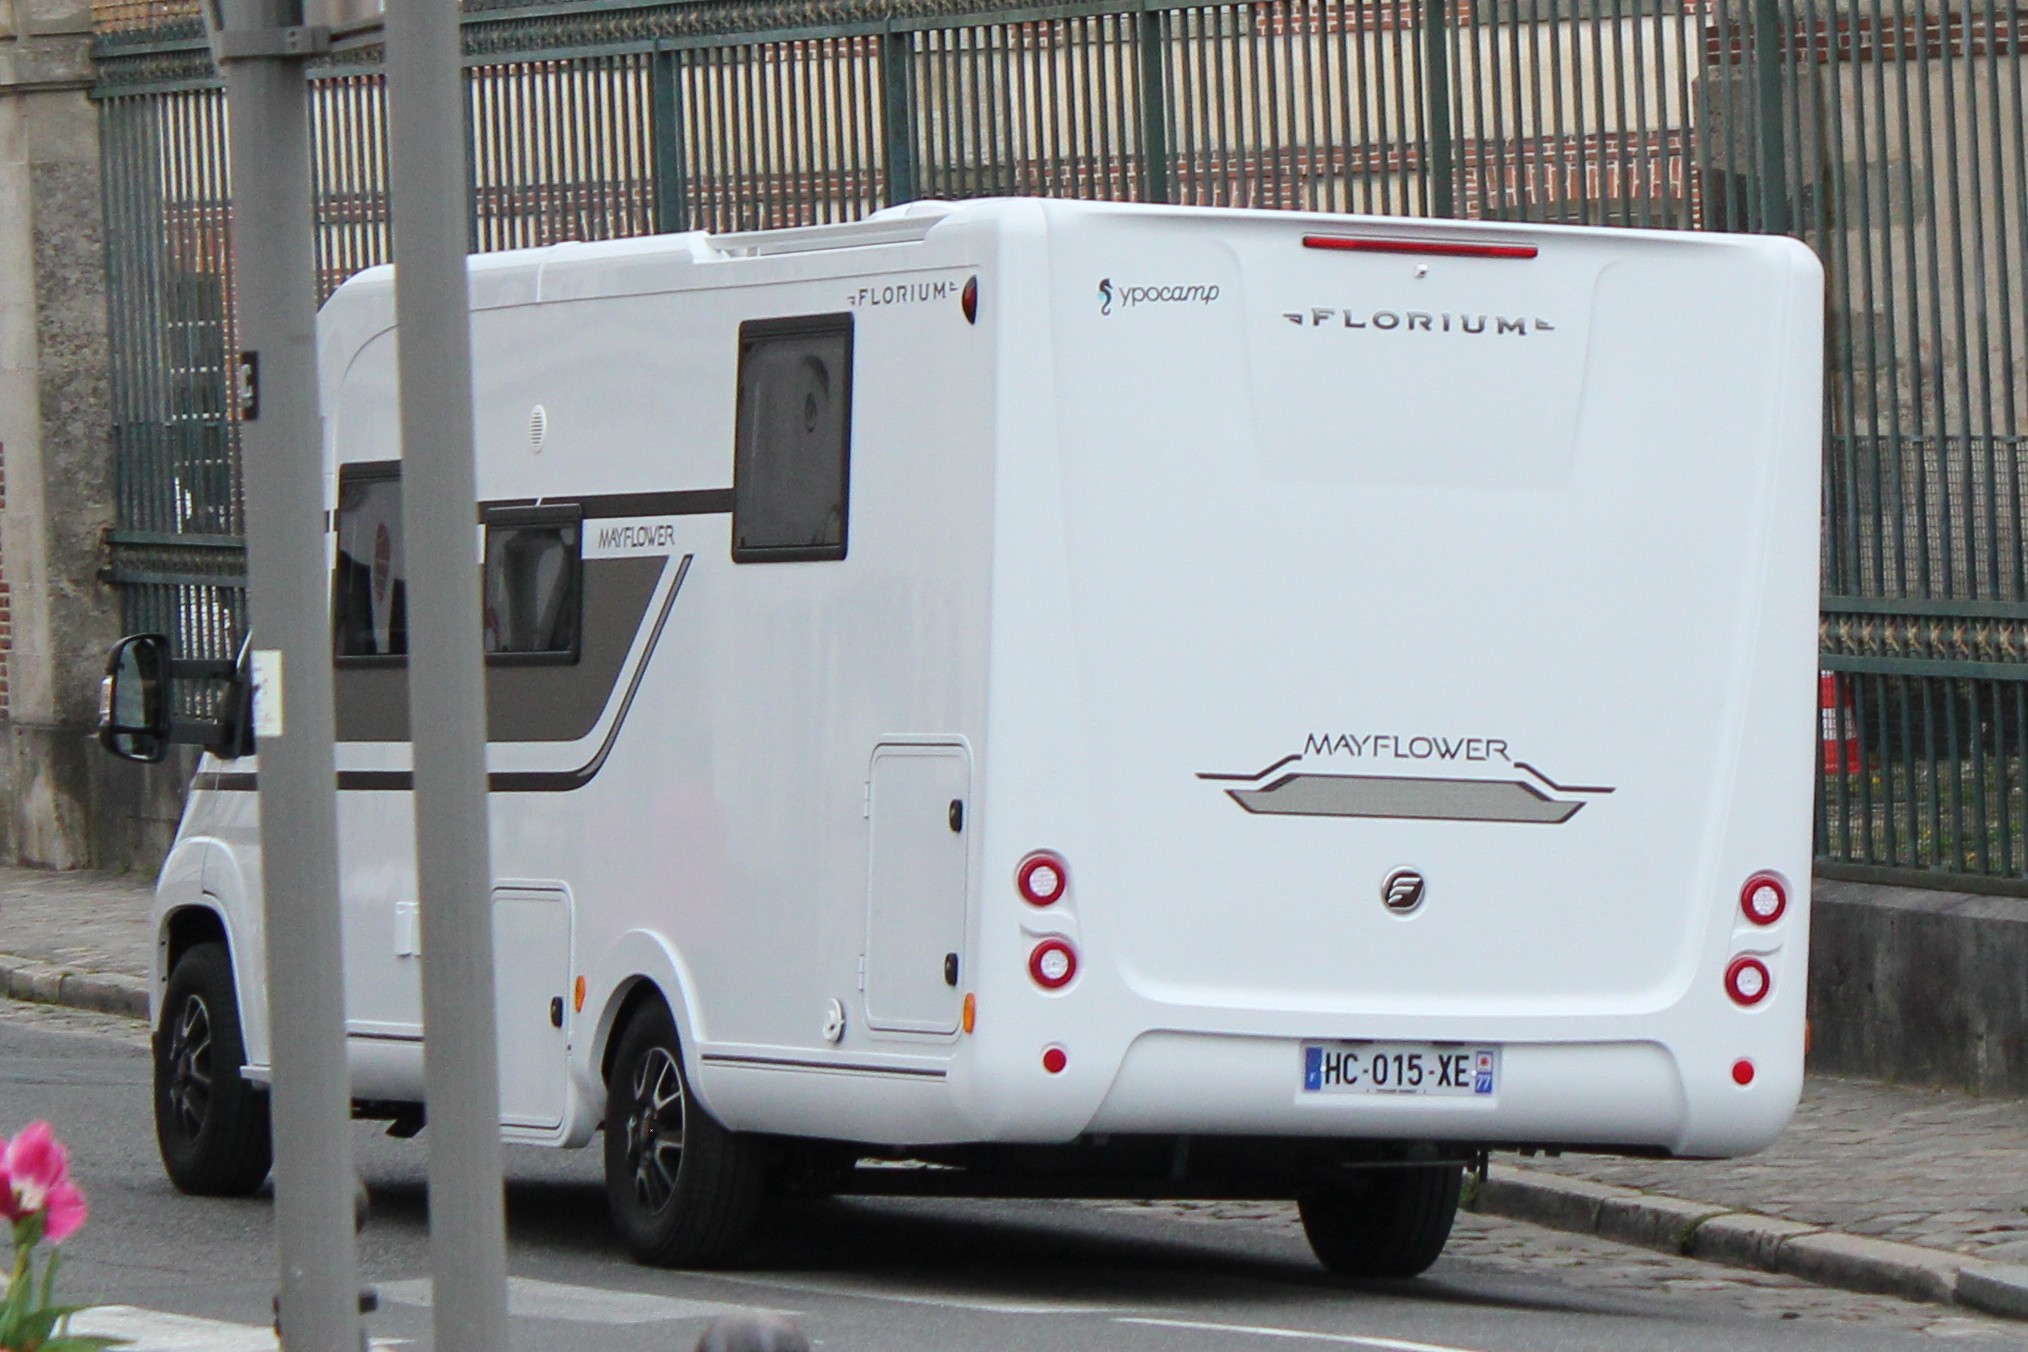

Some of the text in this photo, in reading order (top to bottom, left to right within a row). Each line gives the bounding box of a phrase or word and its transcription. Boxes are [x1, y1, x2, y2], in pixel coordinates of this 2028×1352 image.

[858, 281, 947, 306] FLORIUM
[1311, 307, 1527, 336] FLORIUM
[598, 525, 675, 548] MAYFLOWER
[1303, 732, 1511, 762] MAYFLOWER
[1325, 1052, 1470, 1087] HC-015-XE
